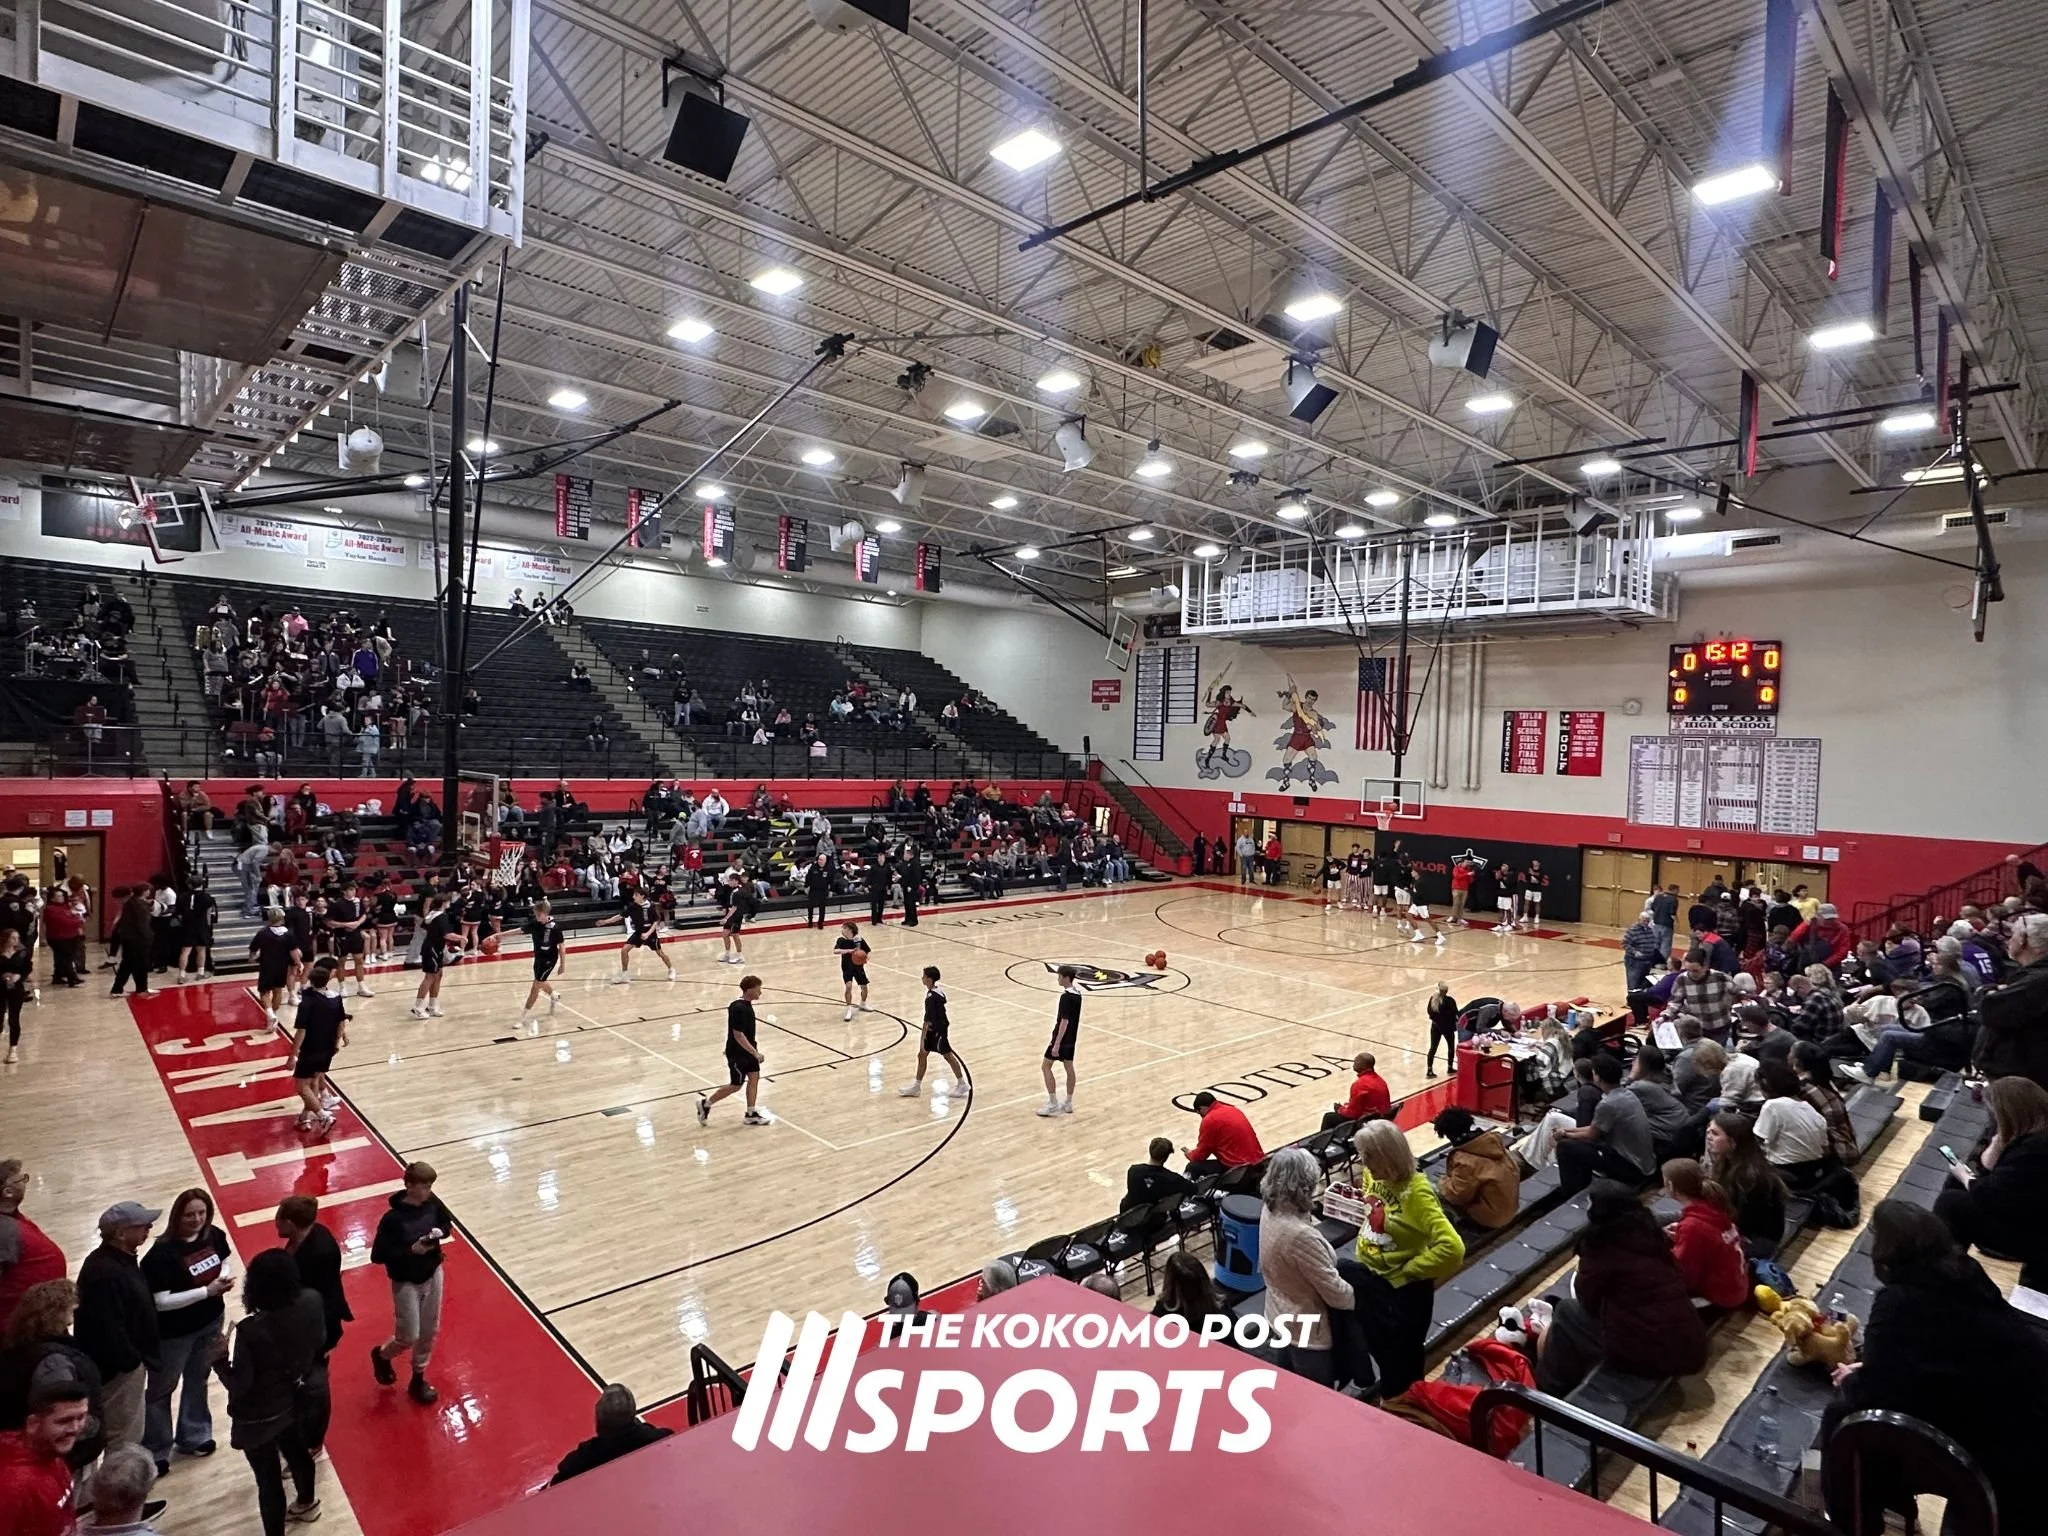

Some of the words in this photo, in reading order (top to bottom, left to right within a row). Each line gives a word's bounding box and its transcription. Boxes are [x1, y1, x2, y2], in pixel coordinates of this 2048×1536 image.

[0, 496, 19, 504] ard
[240, 525, 280, 537] All-Music
[282, 531, 308, 541] Award
[344, 538, 380, 551] All-Music
[381, 544, 404, 554] Award
[552, 564, 571, 574] Award
[1705, 643, 1749, 660] 15:12
[1683, 653, 1696, 670] 0
[1764, 650, 1778, 669] 0
[1674, 688, 1687, 703] 0
[1760, 687, 1774, 702] 0
[1687, 714, 1770, 722] TAYLOR
[1559, 735, 1569, 770] GOLF
[1979, 959, 1992, 974] 15
